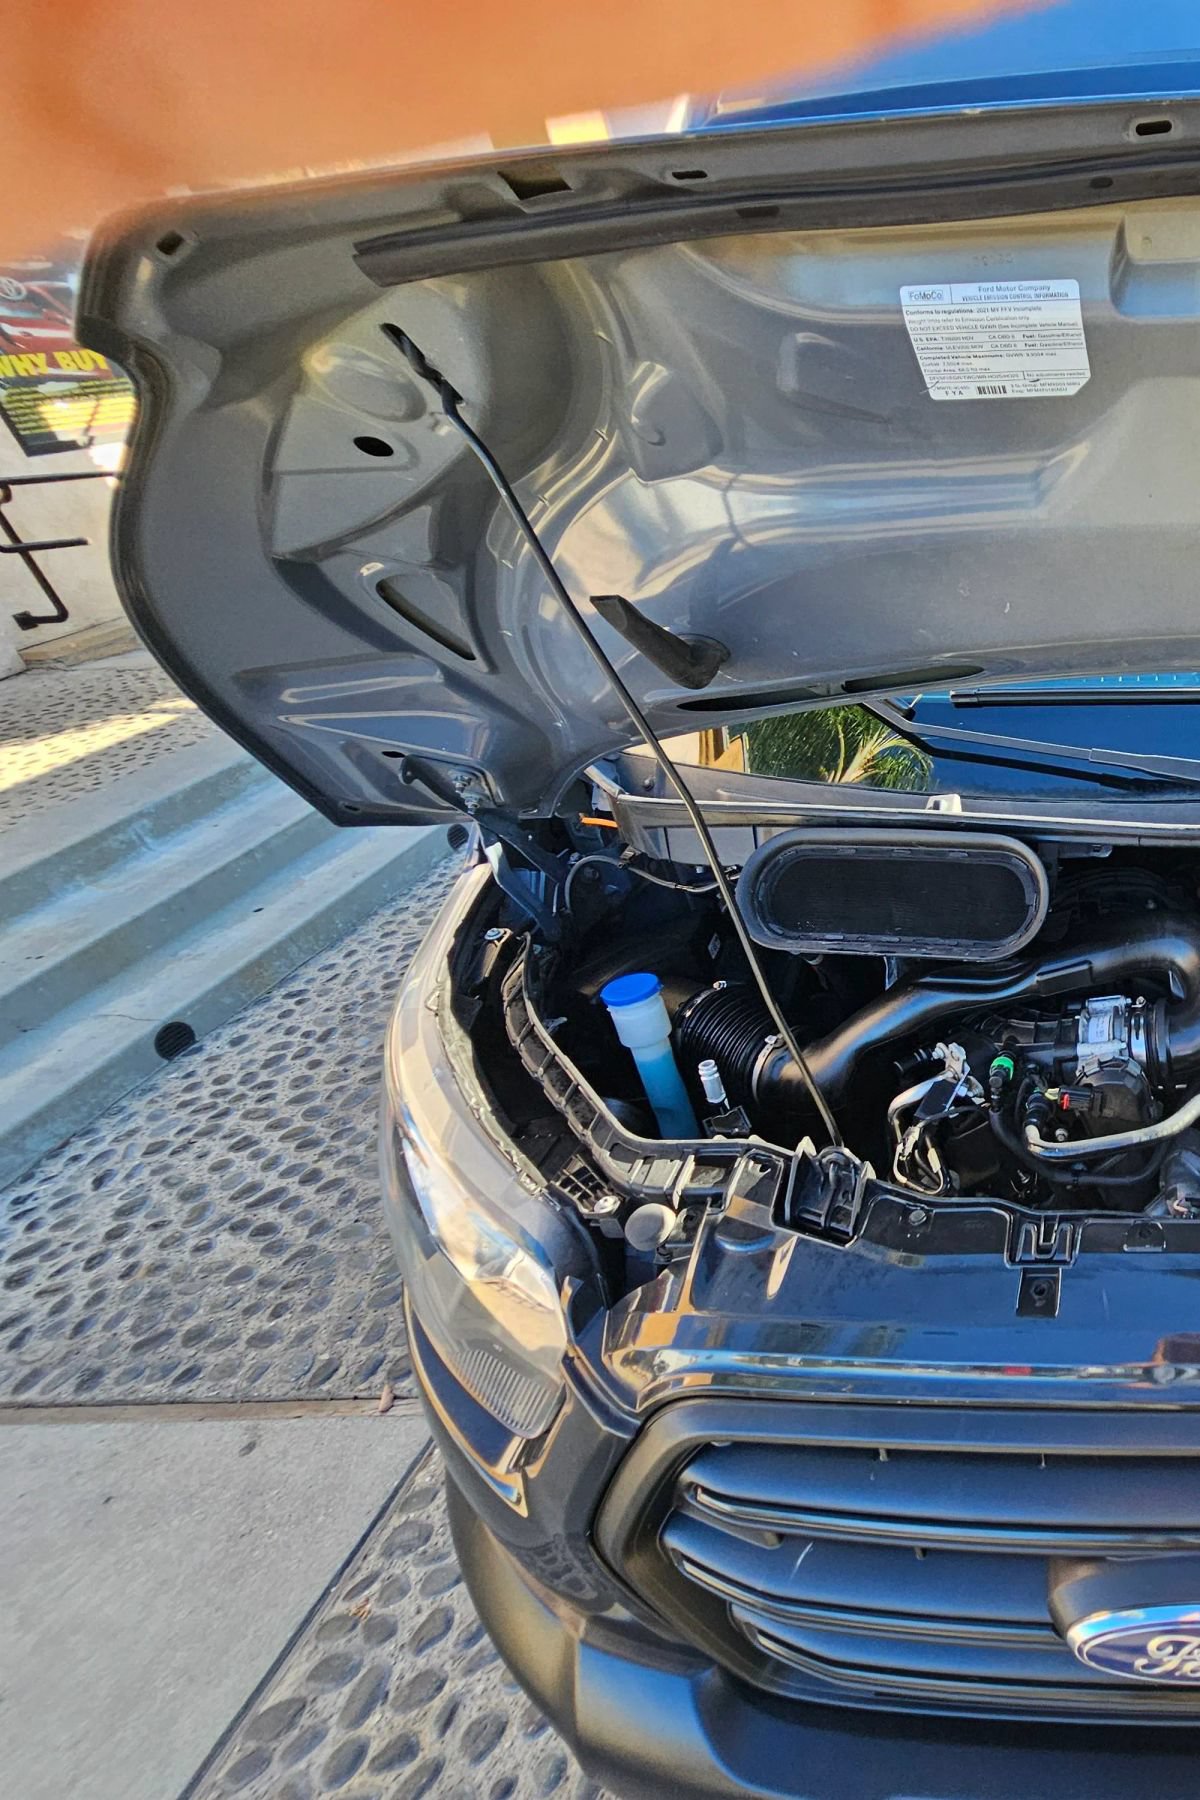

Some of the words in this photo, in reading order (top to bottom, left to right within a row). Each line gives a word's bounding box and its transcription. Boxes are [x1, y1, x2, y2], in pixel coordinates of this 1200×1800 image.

[978, 285, 995, 293] Ford
[1018, 284, 1051, 292] Company
[909, 290, 943, 301] FoMoCo
[52, 348, 110, 371] BUY
